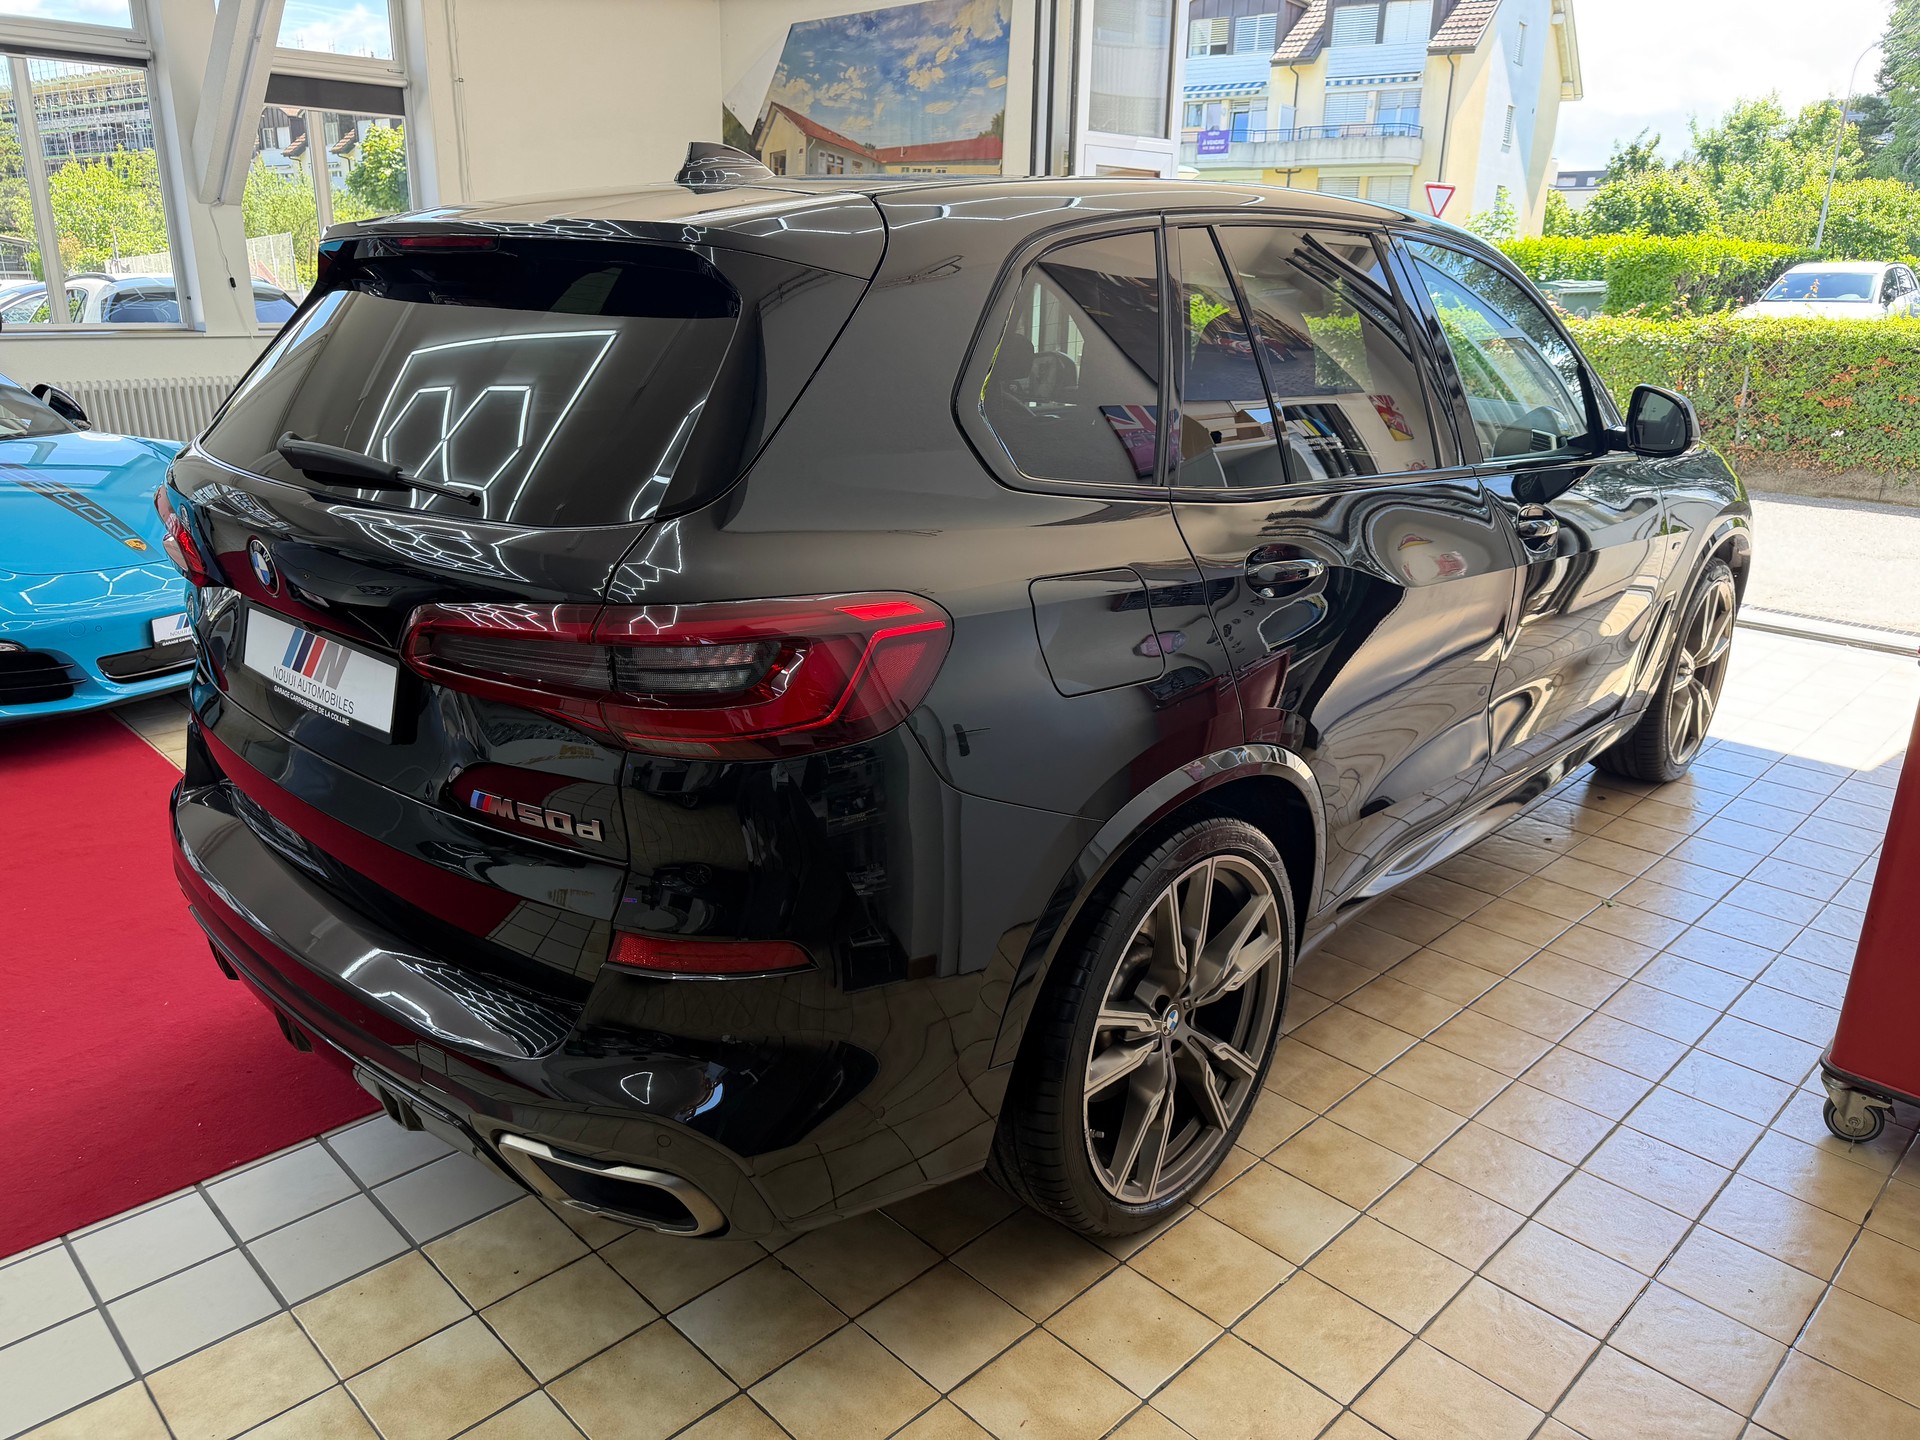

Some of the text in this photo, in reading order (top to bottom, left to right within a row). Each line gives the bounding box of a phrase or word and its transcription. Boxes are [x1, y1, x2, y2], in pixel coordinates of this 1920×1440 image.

[0, 464, 137, 540] PORSC
[274, 685, 350, 726] GARAGE CARROSSERIE DE LA COLLINE
[297, 678, 355, 715] AUTOMOBILES
